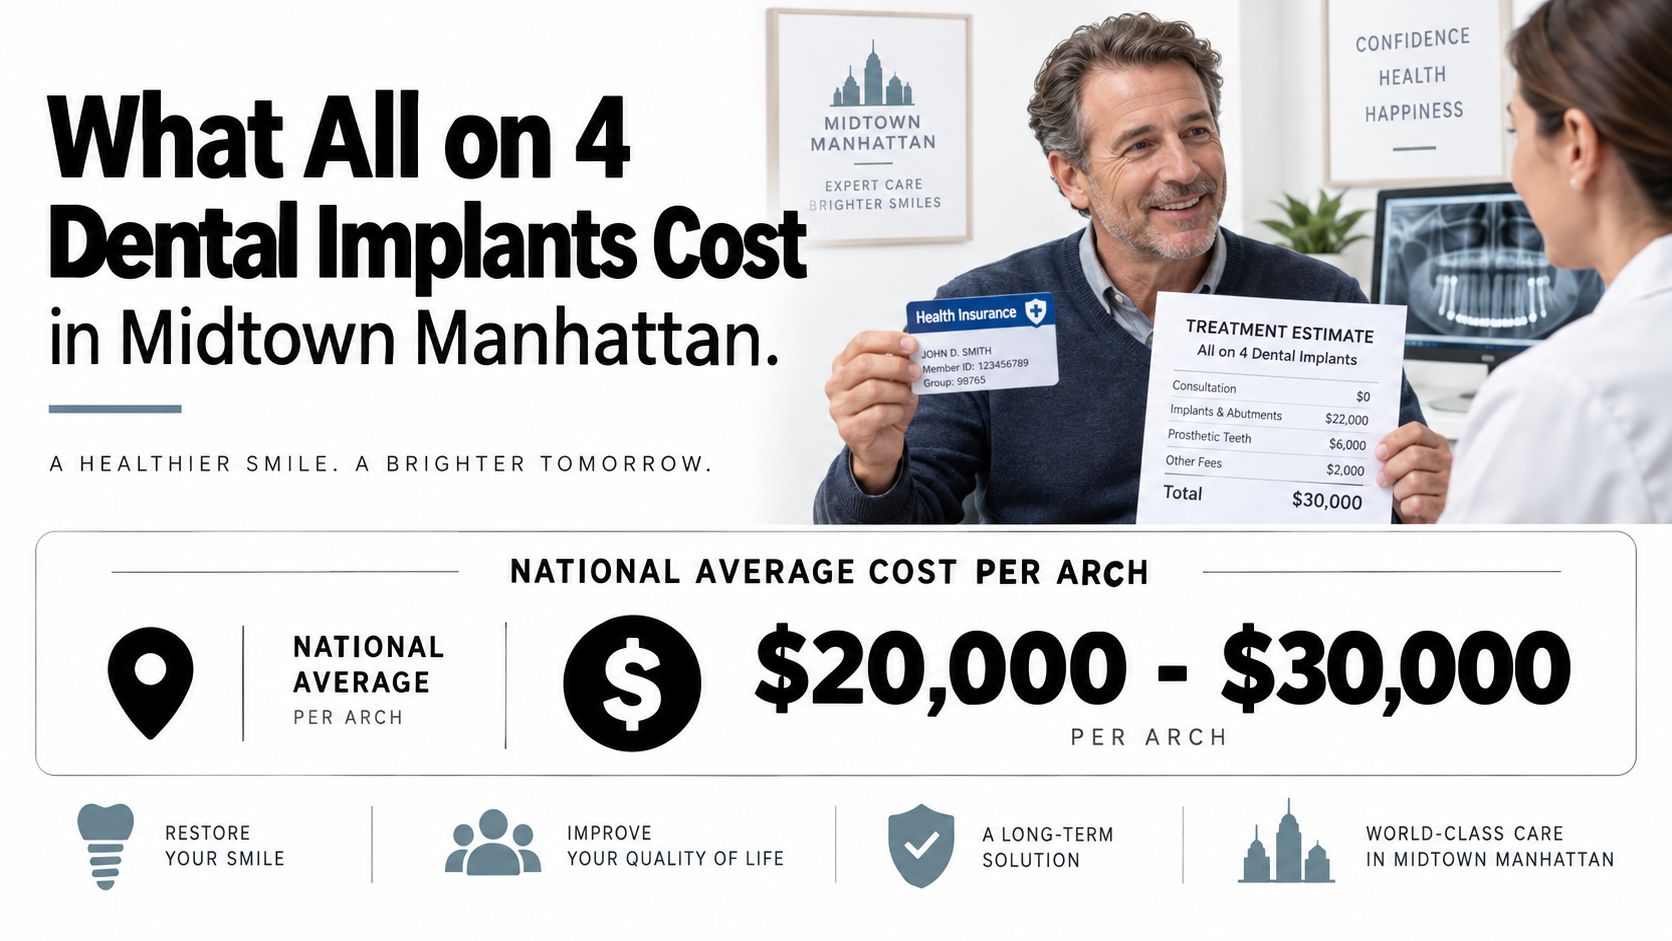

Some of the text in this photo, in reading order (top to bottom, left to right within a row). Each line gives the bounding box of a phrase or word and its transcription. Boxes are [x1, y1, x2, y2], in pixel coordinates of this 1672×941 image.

[1356, 27, 1469, 52] CONFIDENCE
[1380, 66, 1445, 86] HEALTH
[1366, 101, 1463, 122] HAPPINESS
[825, 115, 919, 130] MIDTOWN
[811, 135, 935, 151] MANHATTAN
[826, 178, 922, 192] EXPERT CARE
[809, 197, 941, 211] BRIGHTER SMILES
[917, 308, 1016, 324] Health Insurance
[1187, 319, 1374, 343] TREATMENT ESTIMATE
[921, 347, 991, 359] JOHN D. SMITH
[1197, 344, 1357, 366] All on 4 Dental Implants
[922, 359, 1029, 374] Member ID: 123456789
[922, 375, 986, 388] Group: 98765
[1173, 380, 1370, 402] Consultation $0
[1171, 404, 1368, 425] Implants & Abutments $22,000
[1168, 429, 1366, 451] Prosthetic Teeth $6,000
[1166, 455, 1364, 476] Other Fees $2,000
[1164, 485, 1362, 510] Total $30,000
